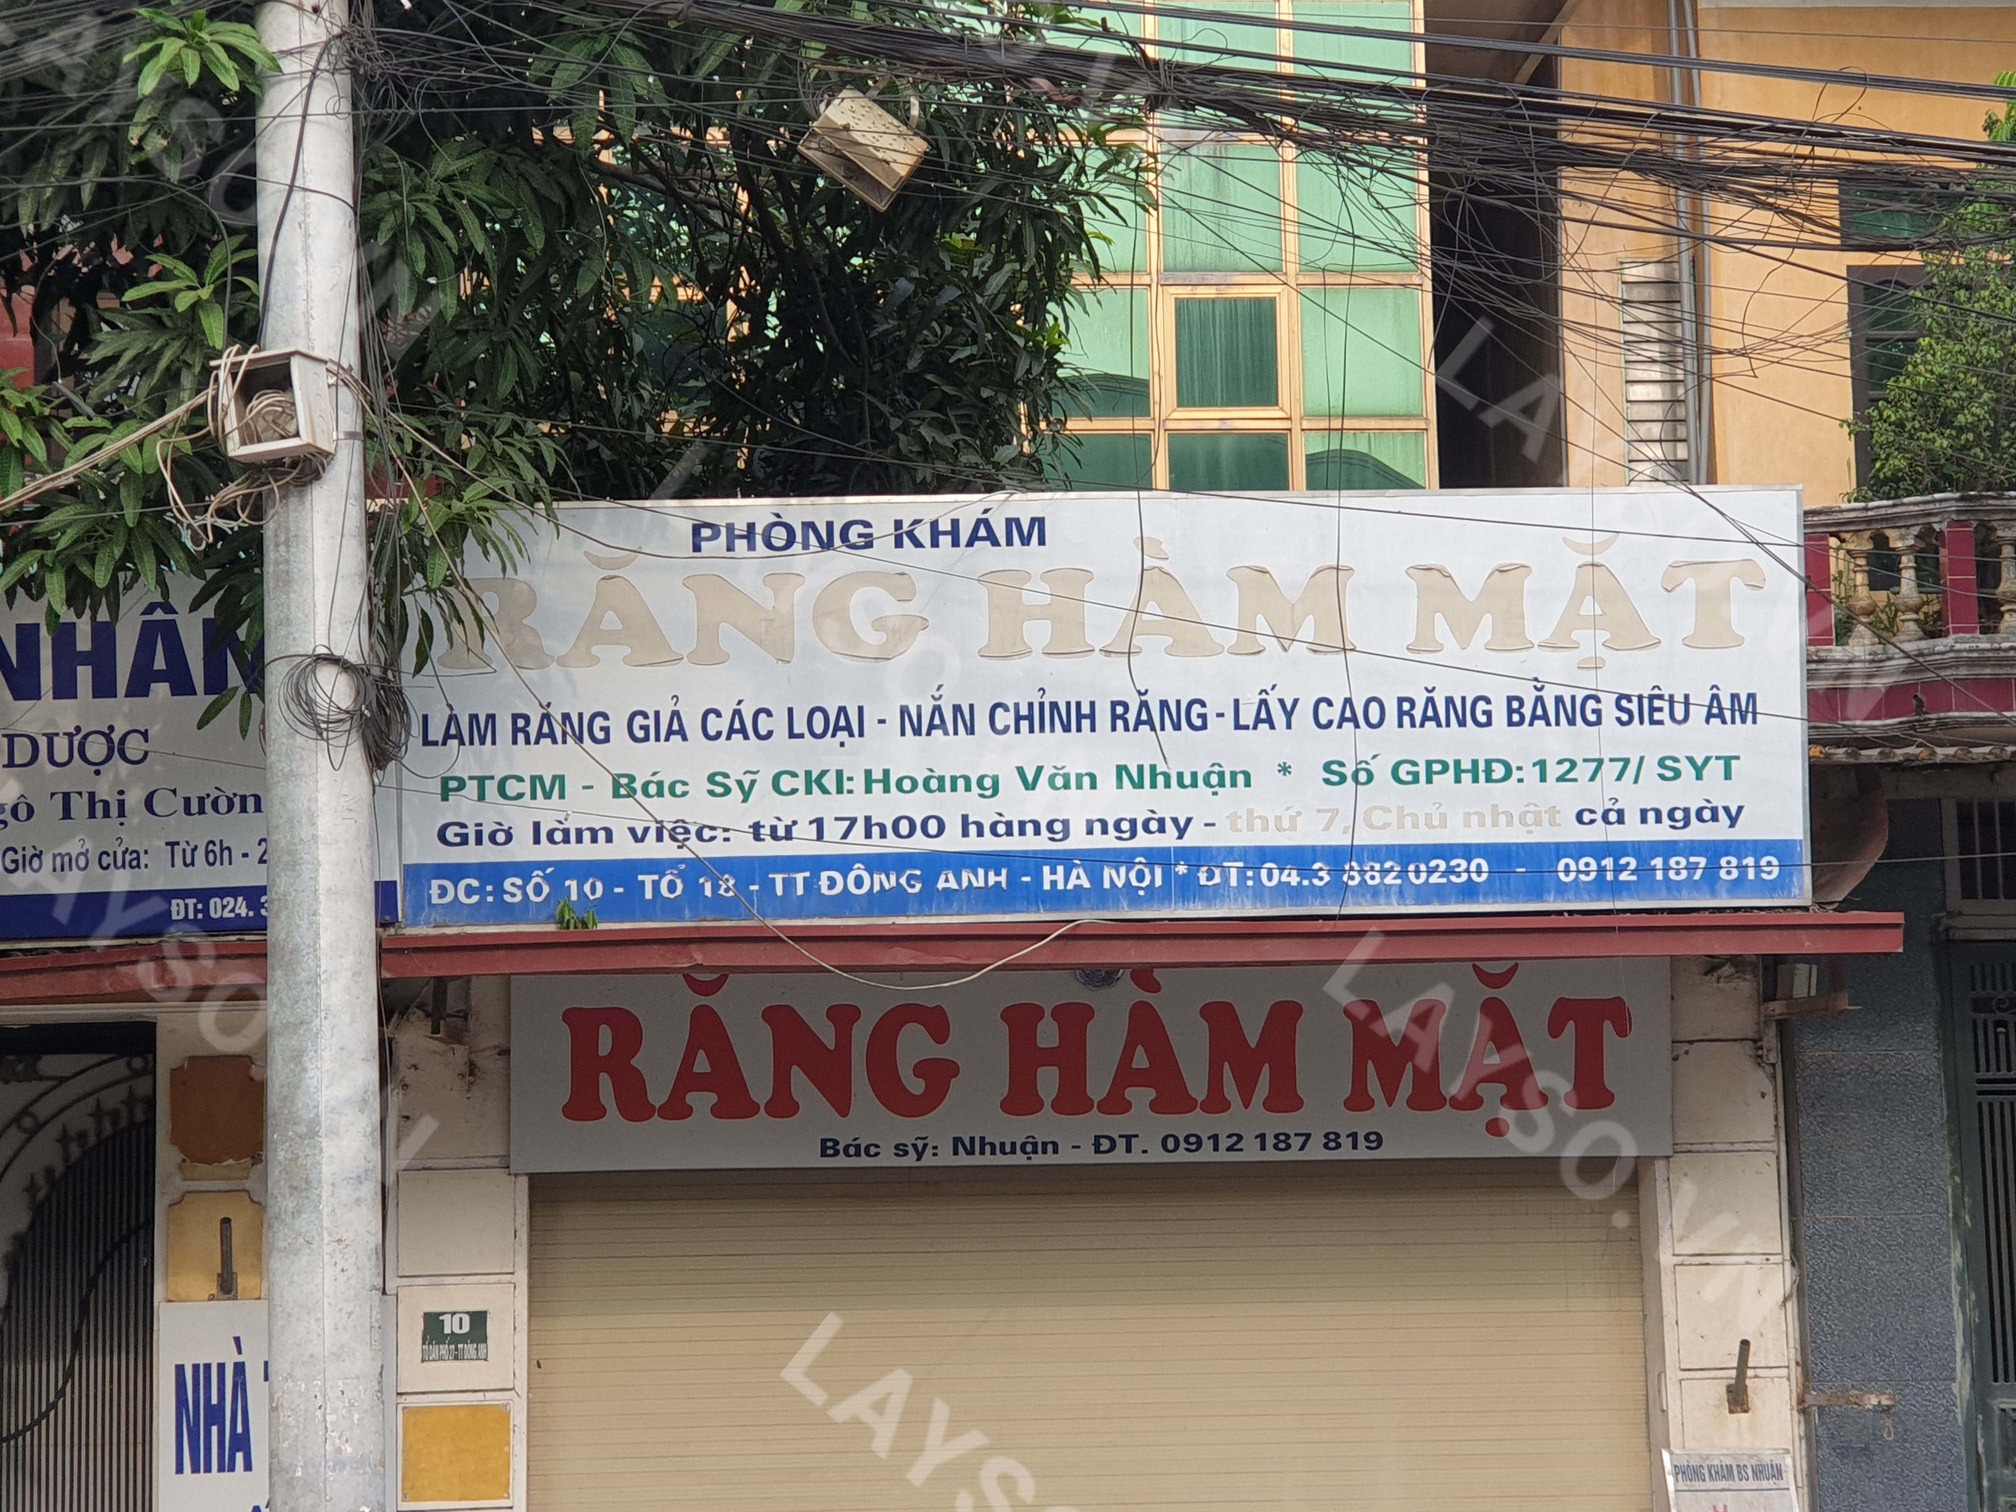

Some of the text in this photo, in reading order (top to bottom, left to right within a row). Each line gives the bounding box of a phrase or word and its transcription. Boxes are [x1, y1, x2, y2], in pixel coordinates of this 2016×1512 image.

[691, 508, 1047, 553] PHÒNG KHÁM
[437, 533, 1766, 669] RĂNG HÀM MẶT
[421, 703, 497, 747] LÀM
[511, 701, 611, 746] RĂNG
[627, 694, 689, 743] GIẢ
[700, 699, 774, 742] CÁC
[787, 705, 865, 748] LOẠI
[899, 684, 976, 738] NẮN
[988, 687, 1096, 734] CHỈNH
[1313, 696, 1386, 730] CAO
[1396, 686, 1493, 728] RĂNG
[1506, 677, 1603, 727] BẰNG
[1615, 684, 1691, 726] SIÊU
[1704, 684, 1758, 725] ÂM
[2, 725, 150, 776] DƯỢC
[440, 774, 566, 802] PTCM
[611, 771, 690, 799] Bác
[706, 770, 759, 803] Sỹ
[1015, 764, 1098, 791] Văn
[1115, 762, 1252, 796] Nhuận
[1322, 753, 1381, 787] Số
[1657, 755, 1741, 782] SYT
[50, 789, 127, 826] Thị
[436, 820, 514, 847] Giờ
[627, 819, 731, 849] việc:
[748, 816, 798, 842] từ
[808, 814, 946, 841] 17h00
[960, 811, 1072, 842] hàng
[1085, 808, 1194, 841] ngày
[1225, 805, 1302, 833] thứ
[1316, 807, 1351, 835] 7,
[1362, 801, 1448, 831] Chủ
[1462, 802, 1562, 835] nhật
[1575, 796, 1626, 827] cả
[1639, 798, 1746, 831] ngày
[1, 845, 43, 874] Giờ
[52, 837, 90, 873] mở
[98, 836, 149, 871] cửa:
[165, 840, 198, 868] Từ
[204, 839, 233, 867] 6h
[565, 877, 604, 901] 10
[637, 864, 686, 899] TỔ
[699, 873, 736, 898] 18
[768, 871, 811, 896] TT
[817, 863, 922, 896] ĐÔNG
[936, 867, 1009, 892] ANH
[1043, 860, 1091, 891] HÀ
[1103, 857, 1163, 896] NỘI
[1556, 856, 1638, 883] 0912
[1650, 856, 1707, 882] 187
[1719, 855, 1781, 881] 819
[170, 898, 202, 921] ĐT:
[209, 896, 254, 918] 024.
[561, 961, 1633, 1138] RĂNG HÀM MẶT
[818, 1136, 881, 1159] Bác
[893, 1134, 940, 1162] sỹ:
[951, 1134, 1060, 1161] Nhuận
[1092, 1133, 1149, 1156] ĐT.
[1160, 1131, 1245, 1155] 0912
[1254, 1131, 1313, 1154] 187
[1321, 1129, 1384, 1153] 819
[439, 1313, 470, 1334] 10
[174, 1336, 253, 1475] NHÀ
[1737, 1464, 1750, 1482] BS
